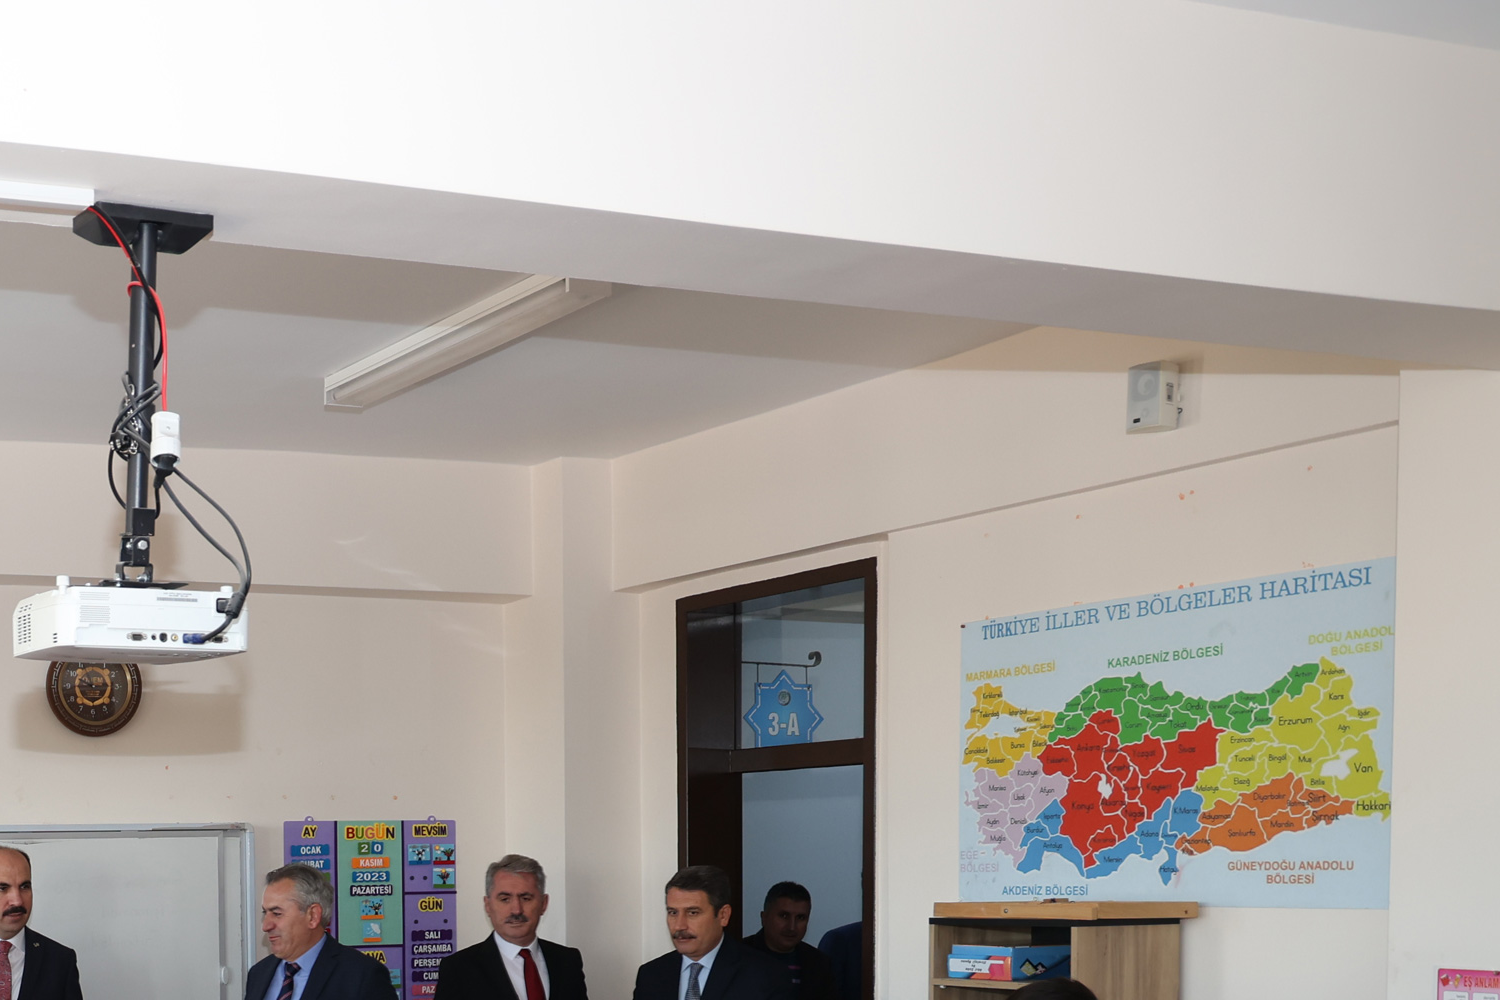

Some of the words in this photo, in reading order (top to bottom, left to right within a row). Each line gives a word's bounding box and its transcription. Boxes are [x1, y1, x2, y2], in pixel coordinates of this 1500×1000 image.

[982, 616, 1040, 641] TÜRKİYE
[1045, 608, 1100, 631] İLLER
[1105, 603, 1130, 621] VE
[1137, 585, 1252, 618] BÖLGELER
[1259, 566, 1372, 600] HARİTASI
[1308, 631, 1342, 645] DOĞU
[1331, 640, 1384, 657] BÖLGESİ
[1107, 650, 1169, 669] KARADENİZ
[1173, 642, 1224, 661] BÖLGESİ
[966, 668, 1012, 682] MARMARA
[1014, 660, 1056, 676] BÖLGESİ
[1329, 692, 1344, 700] Kars
[1186, 702, 1203, 711] Ordu
[768, 712, 800, 736] 3-A
[1278, 716, 1313, 726] Erzurum
[1354, 763, 1373, 773] Van
[1356, 800, 1391, 811] Hakkari
[302, 826, 317, 838] AY
[345, 823, 395, 840] BUGÜN
[414, 823, 447, 836] MEVSİM
[300, 846, 321, 855] OCAK
[960, 850, 979, 860] EGE
[301, 860, 324, 868] UBAT
[359, 859, 383, 867] KASIM
[960, 863, 999, 873] BÖLGESİ
[1227, 859, 1296, 871] GÜNEYDOĞU
[1298, 860, 1354, 870] ANADOLU
[356, 872, 387, 881] 2023
[1266, 873, 1315, 884] BÖLGESİ
[352, 886, 392, 895] PAZARTESİ
[1002, 885, 1044, 896] AKDENİZ
[1045, 884, 1089, 896] BÖLGESİ
[419, 897, 443, 911] GÜN
[424, 931, 441, 939] SALI
[413, 944, 452, 954] ÇARŞAMBA
[423, 972, 439, 980] CUM
[1463, 976, 1472, 990] EŞ
